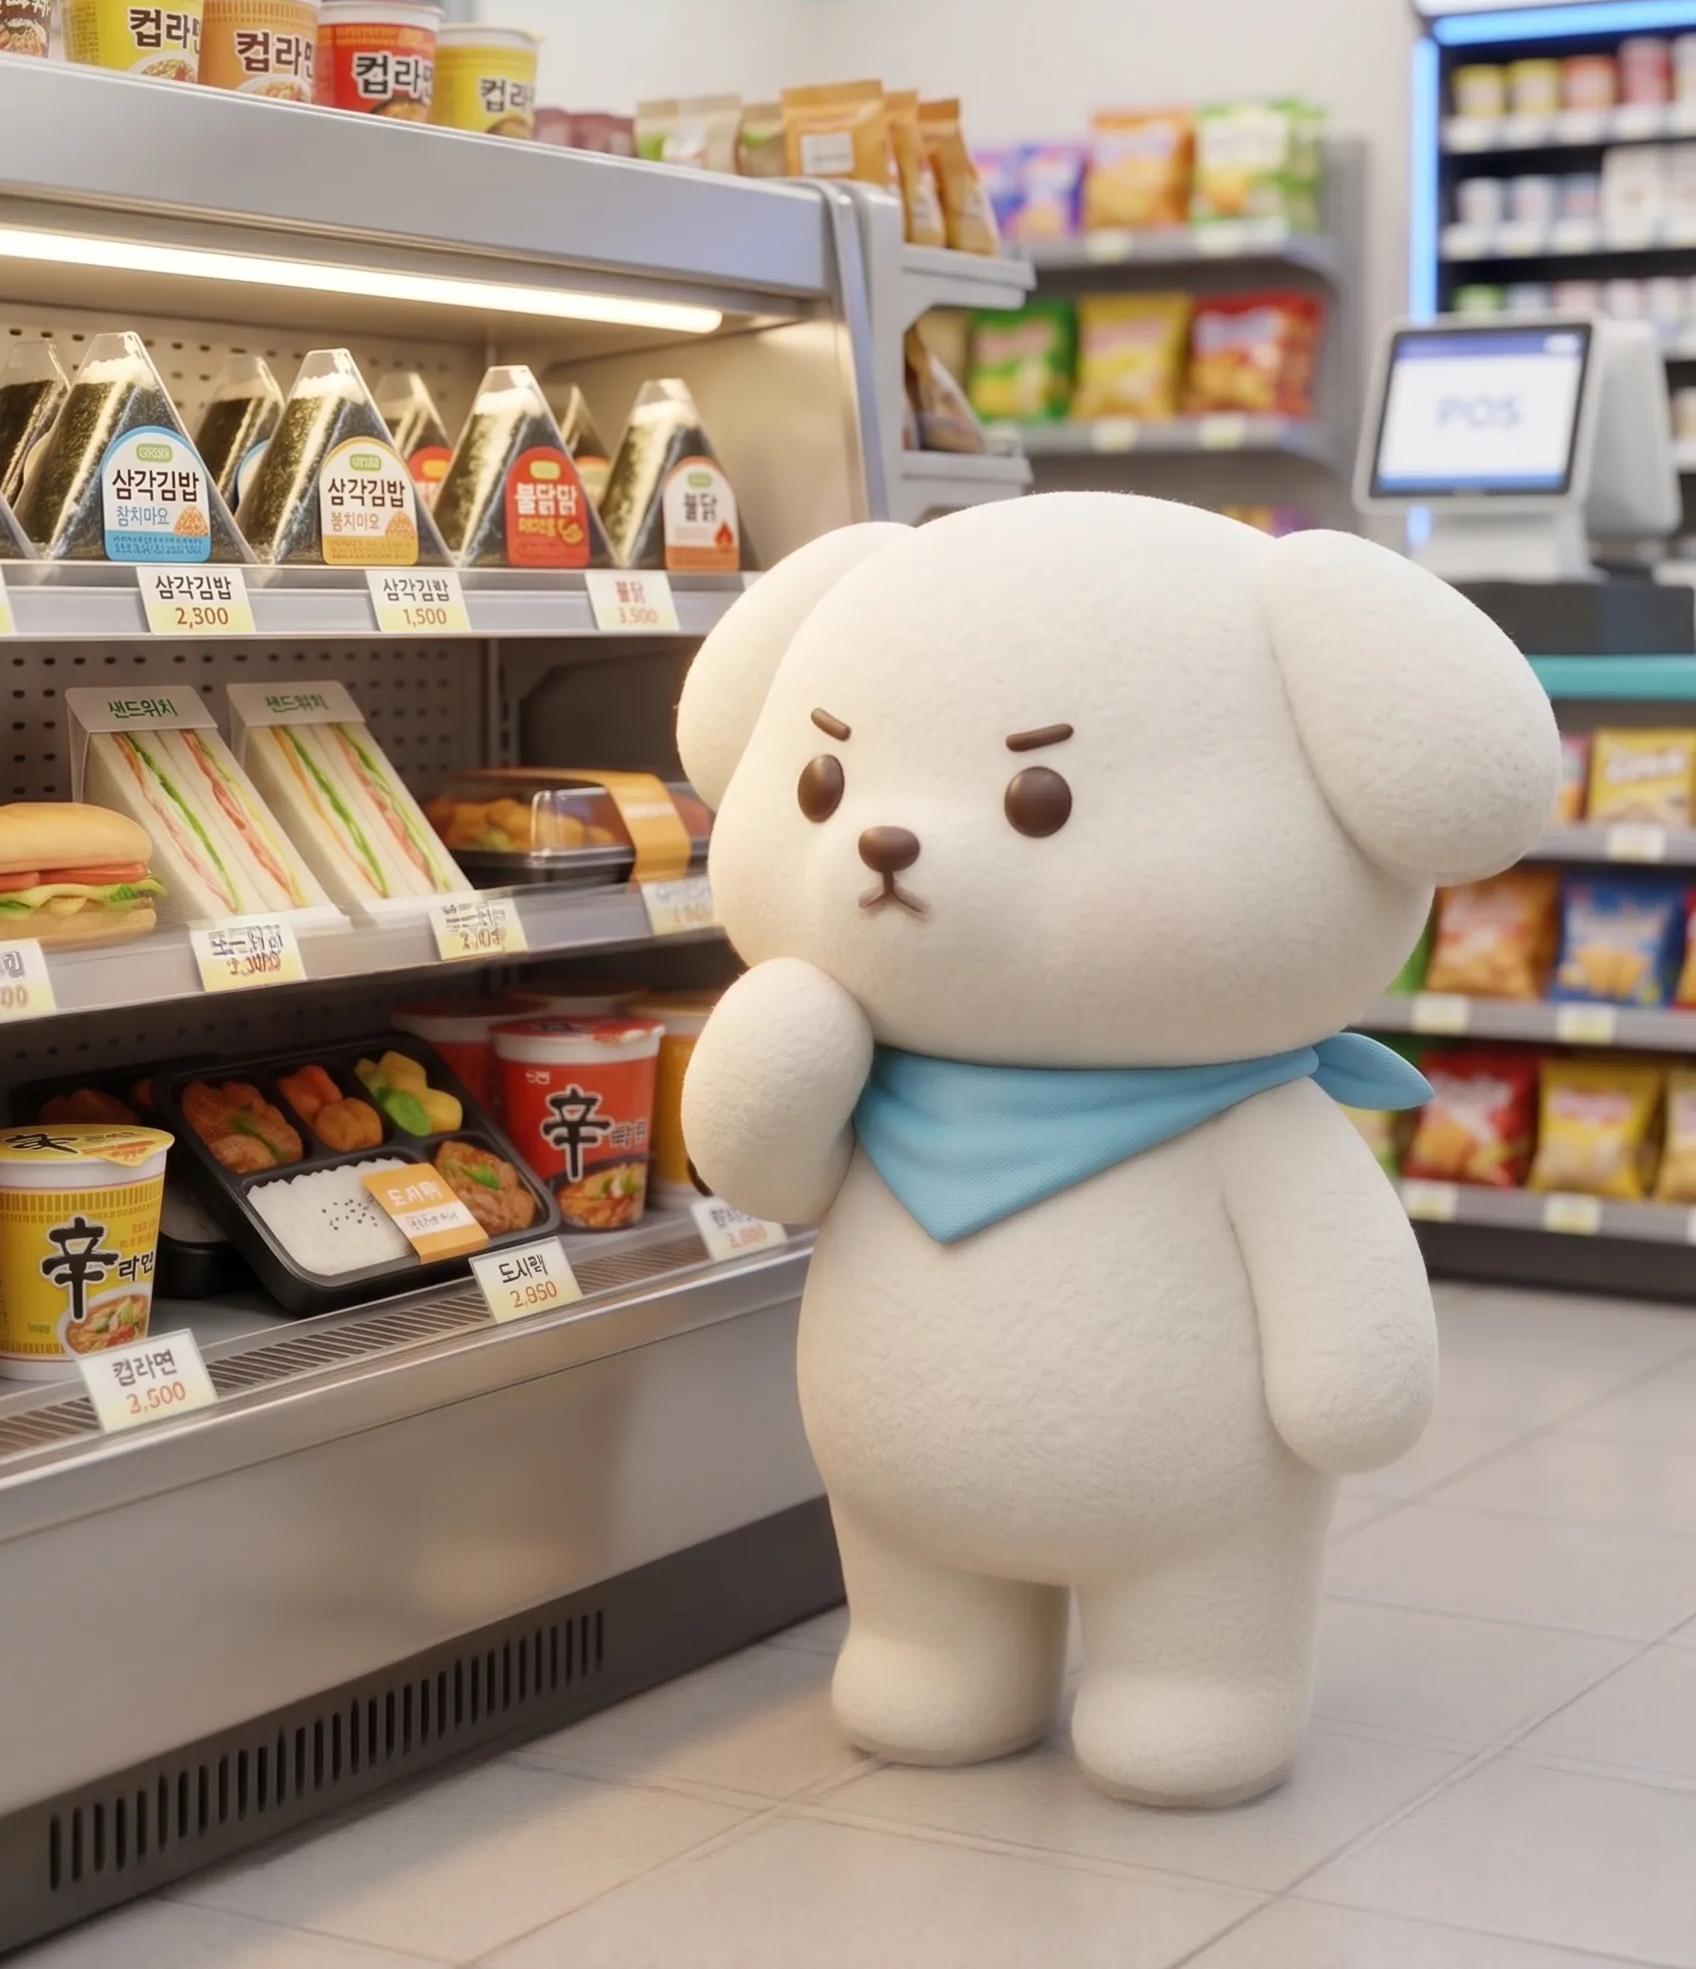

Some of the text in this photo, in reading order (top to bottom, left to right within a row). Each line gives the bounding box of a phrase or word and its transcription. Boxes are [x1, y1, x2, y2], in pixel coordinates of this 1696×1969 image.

[112, 468, 199, 502] 삼각김밥
[328, 477, 406, 508] 삼각김밥
[116, 505, 170, 527] 참치마요
[155, 575, 232, 601] 삼각김밥
[383, 578, 450, 602] 삼각김밥
[174, 606, 229, 629] 2,300
[402, 607, 448, 629] 1,500
[107, 698, 178, 719] 샌드위치
[542, 1083, 612, 1180] 辛
[41, 1216, 120, 1320] 辛
